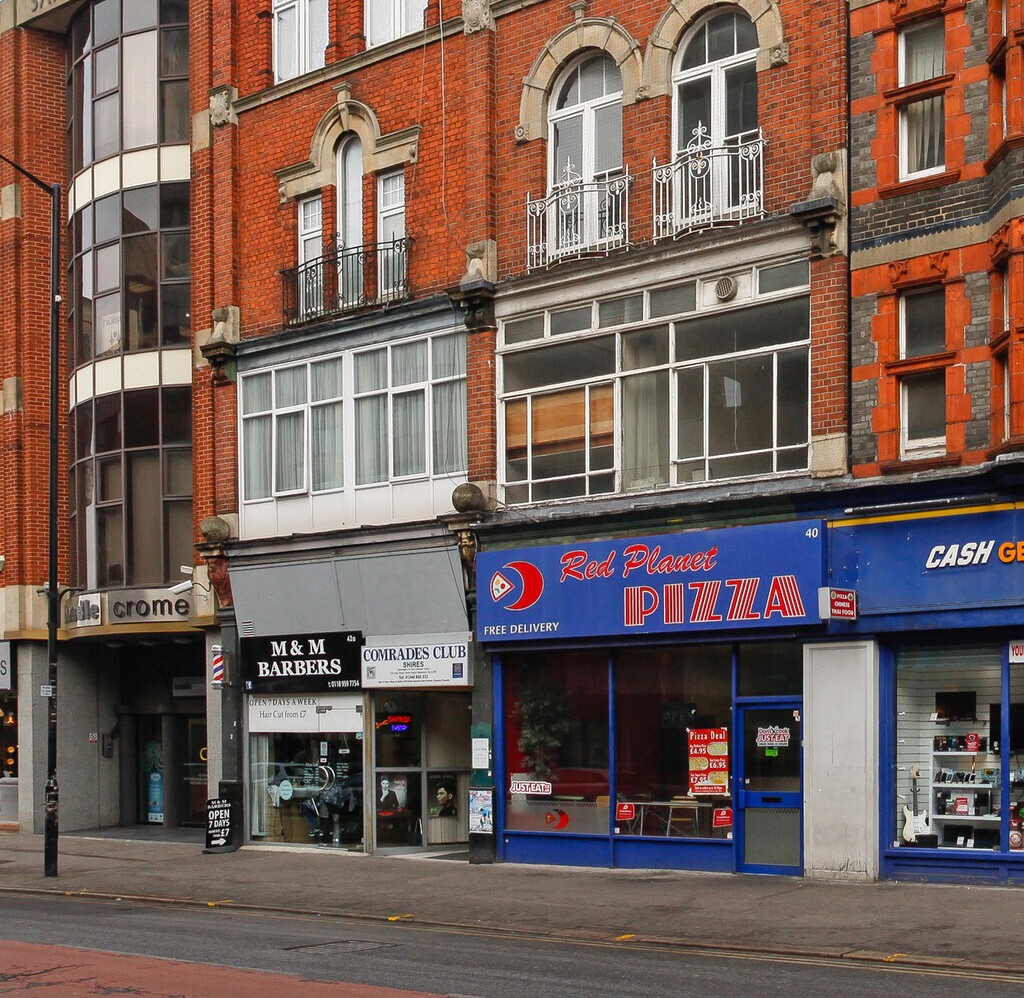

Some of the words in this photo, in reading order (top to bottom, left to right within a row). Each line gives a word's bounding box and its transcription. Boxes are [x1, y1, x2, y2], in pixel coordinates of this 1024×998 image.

[805, 528, 819, 538] 40
[925, 540, 996, 569] CASH
[560, 550, 616, 583] Red
[622, 543, 719, 579] Planet
[624, 574, 806, 626] PIZZA
[113, 598, 190, 618] crome
[484, 625, 507, 635] FREE
[510, 622, 560, 633] DELIVERY
[270, 640, 288, 657] M
[290, 639, 304, 656] &
[308, 638, 326, 655] M
[363, 647, 429, 662] COMRADES
[433, 645, 466, 659] CLUB
[257, 658, 342, 677] BARBERS
[259, 711, 272, 719] Hair
[284, 710, 299, 718] from
[690, 732, 708, 740] Pizza
[710, 731, 726, 739] Deal
[758, 734, 774, 742] JUST
[775, 734, 789, 742] EAT
[512, 782, 530, 792] JUST
[531, 783, 545, 792] EAT
[208, 809, 230, 820] OPEN
[213, 819, 230, 828] DAYS
[220, 828, 230, 836] £7
